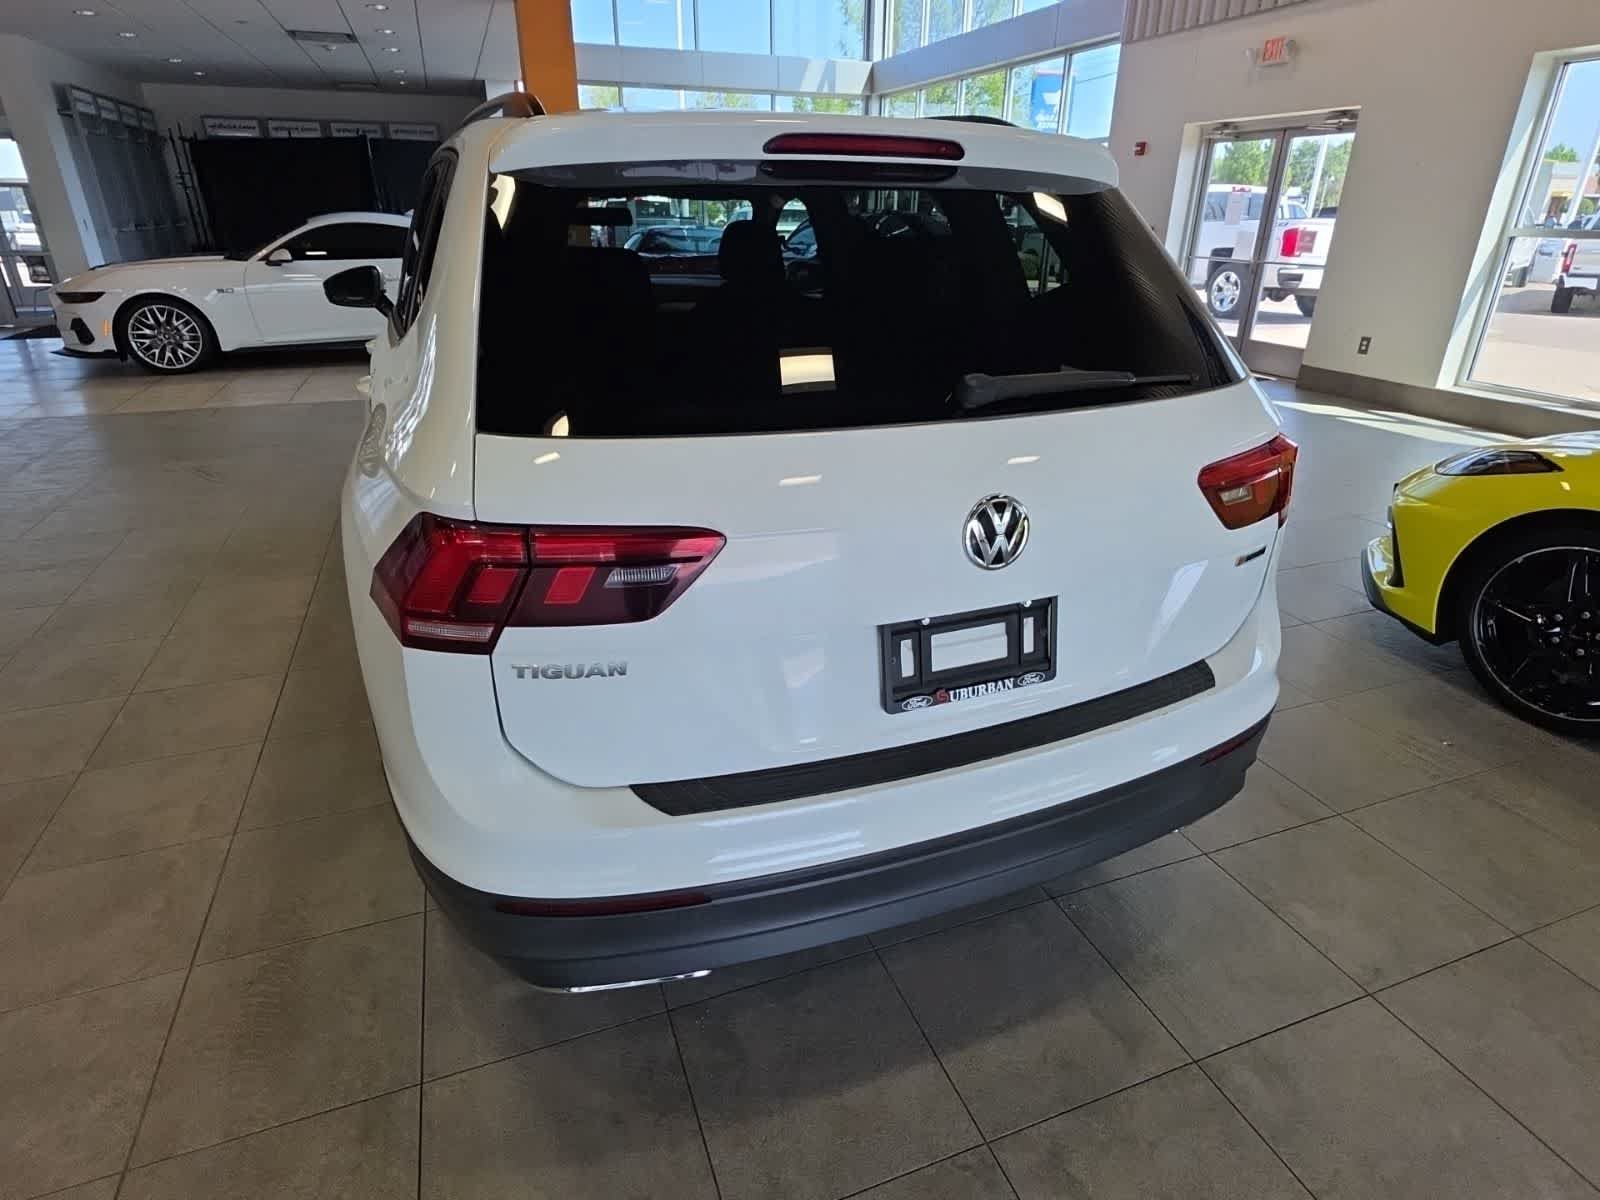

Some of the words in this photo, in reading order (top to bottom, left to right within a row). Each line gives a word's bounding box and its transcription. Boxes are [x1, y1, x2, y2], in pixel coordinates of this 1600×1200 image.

[1262, 37, 1286, 62] EXIT
[511, 662, 628, 680] TIGUAN
[936, 678, 1014, 704] SUBURBAN
